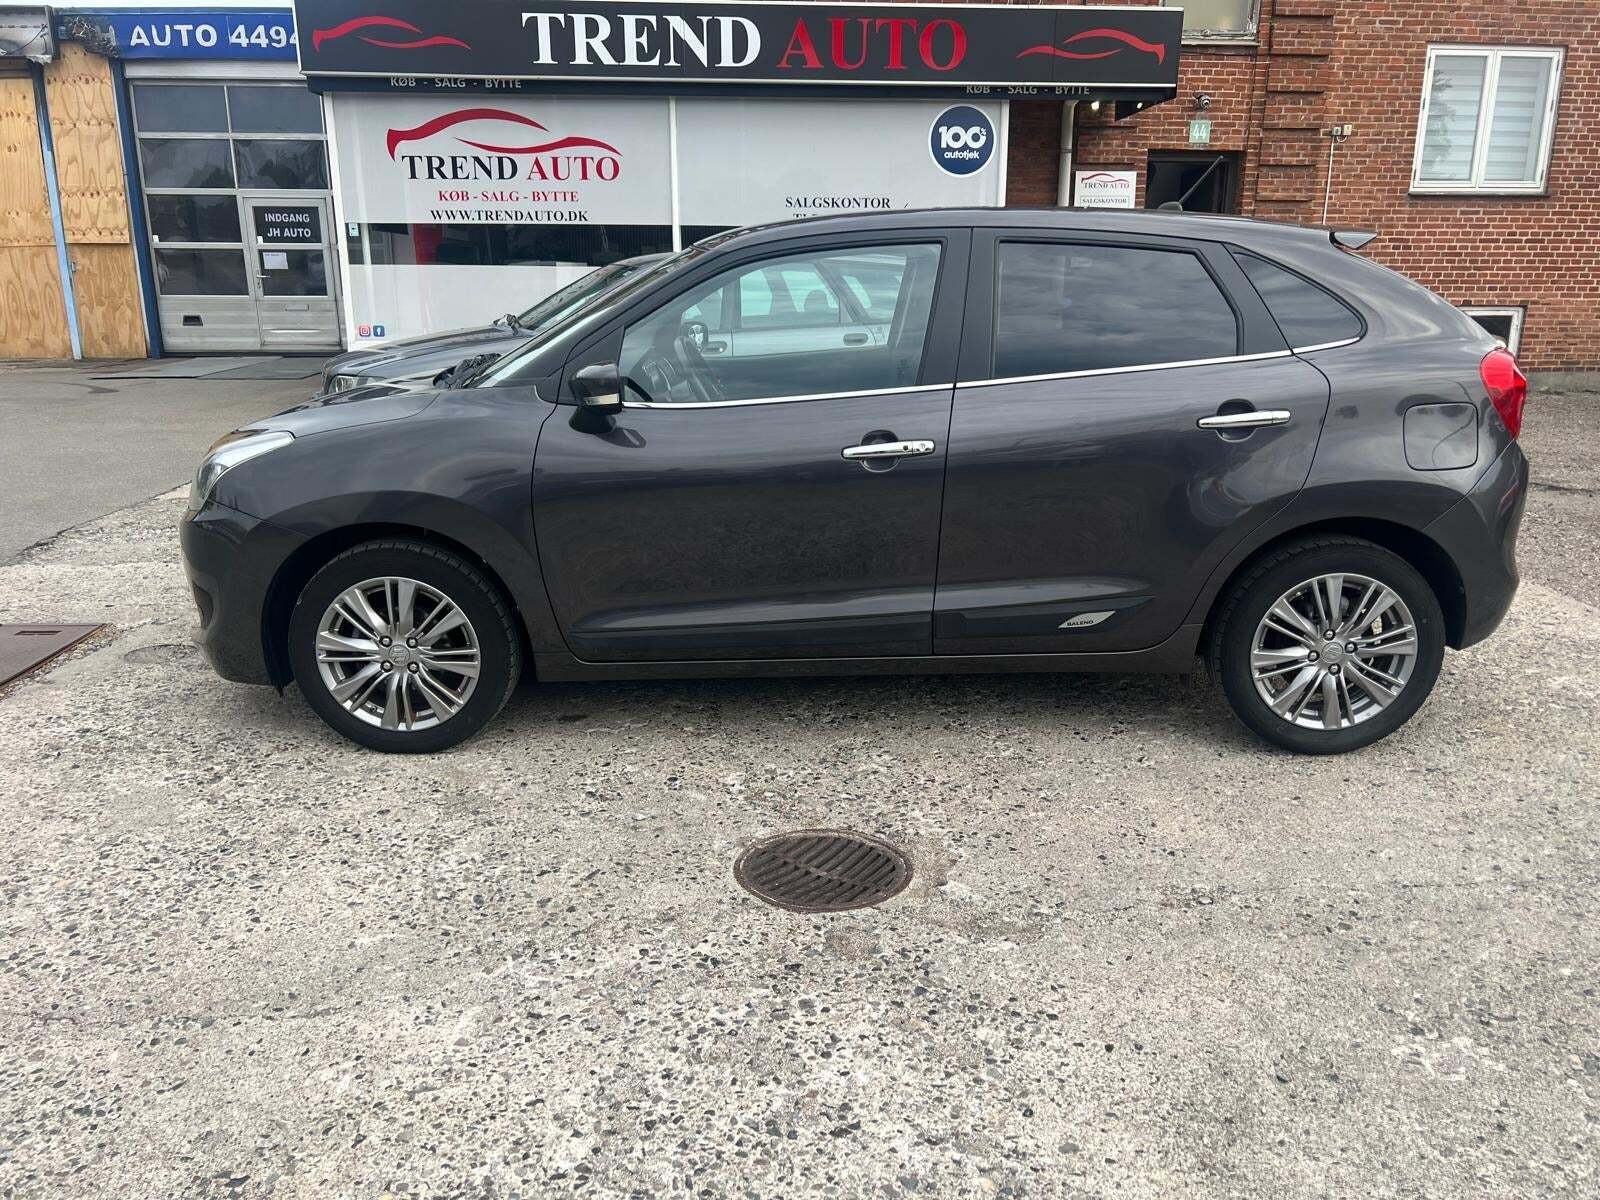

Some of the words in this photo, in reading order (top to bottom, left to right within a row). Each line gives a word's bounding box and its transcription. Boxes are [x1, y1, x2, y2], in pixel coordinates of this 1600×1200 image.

[130, 24, 218, 47] AUTO
[521, 12, 762, 69] TREND
[776, 17, 968, 71] AUTO
[390, 76, 416, 87] KØB
[434, 78, 466, 88] SALG
[485, 79, 521, 88] BYTTE
[966, 85, 990, 94] KØB
[1008, 85, 1037, 94] SALG
[1055, 86, 1090, 95] BYTTE
[1192, 124, 1207, 139] 44
[944, 149, 979, 160] autotjek
[401, 155, 518, 180] TREND
[527, 155, 620, 181] AUTO
[437, 191, 470, 202] KØB
[481, 191, 519, 202] SALG
[532, 191, 579, 202] BYTTE
[785, 196, 891, 209] SALGSKONTOR
[264, 213, 310, 223] INDGANG
[430, 209, 588, 222] WWW.TRENDAUTO.DK
[267, 228, 281, 237] JH
[284, 228, 312, 238] AUTO
